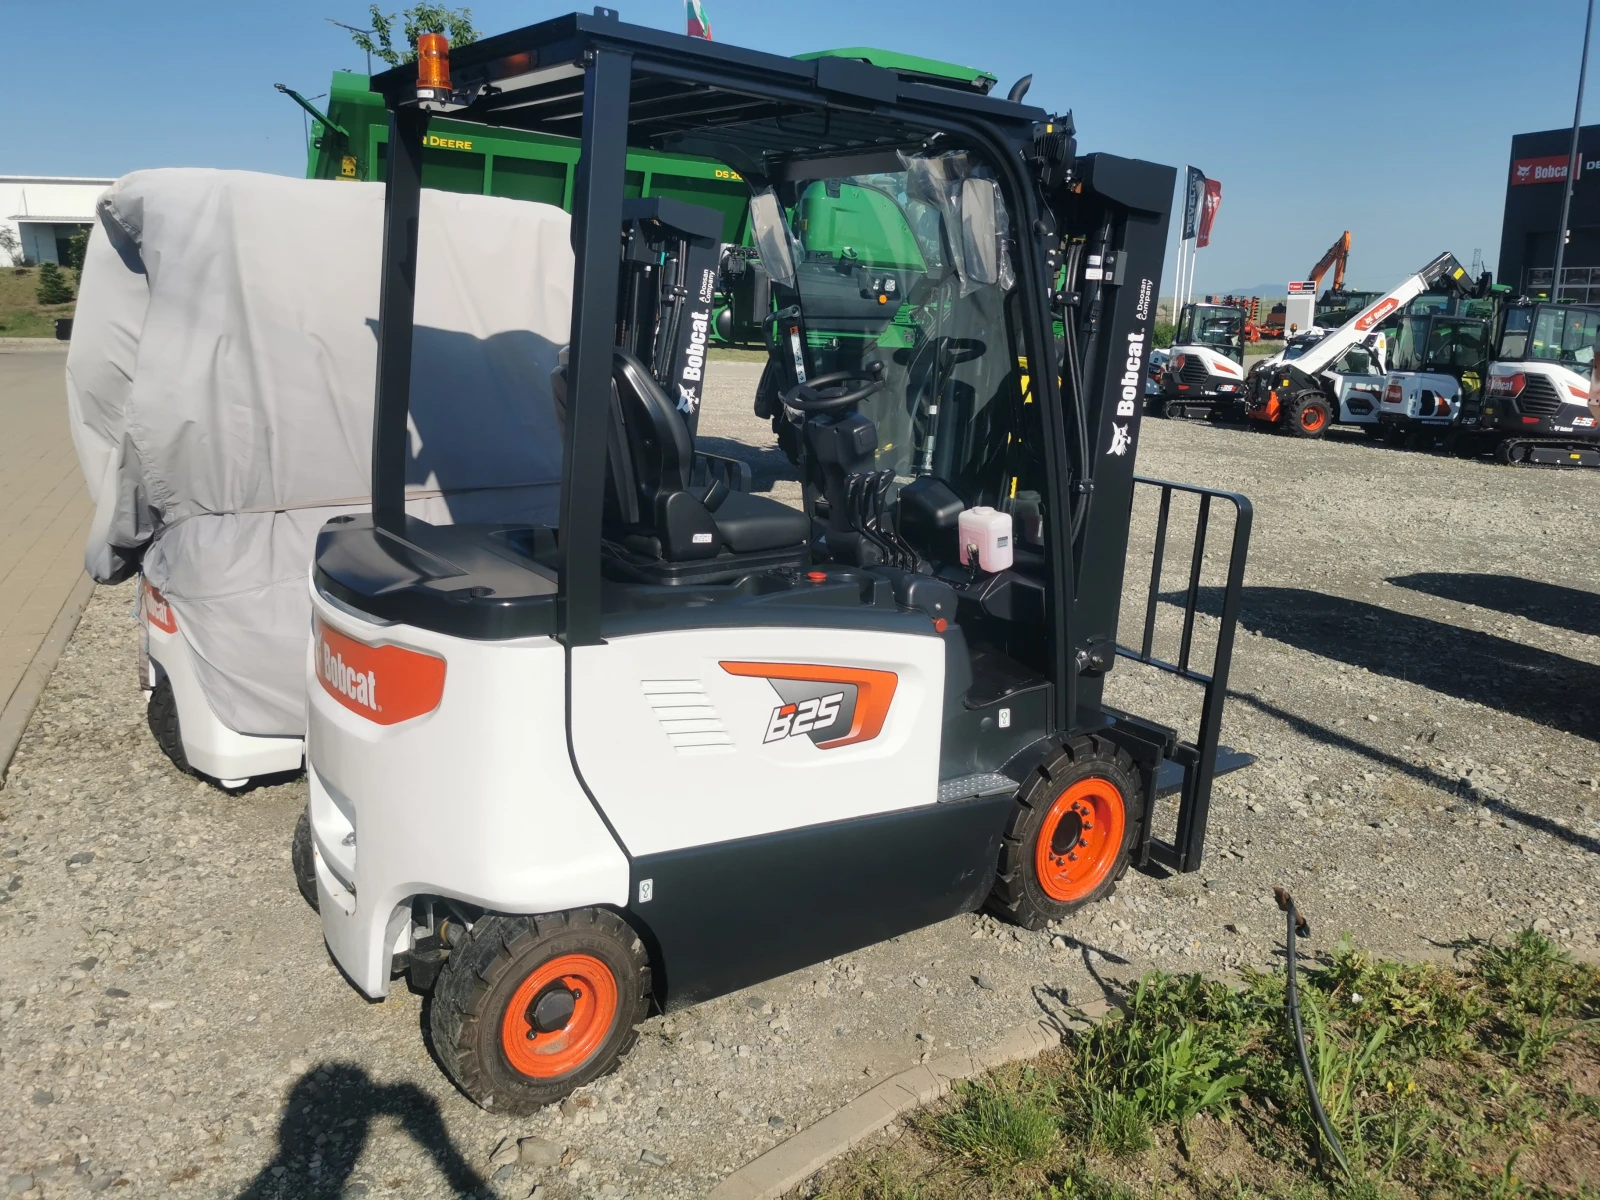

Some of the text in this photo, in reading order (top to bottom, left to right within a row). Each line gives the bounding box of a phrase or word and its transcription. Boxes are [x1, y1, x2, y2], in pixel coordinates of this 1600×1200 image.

[430, 135, 472, 150] DEERE
[715, 169, 729, 179] DS
[1534, 164, 1568, 180] Bobca
[700, 269, 709, 296] Doosan
[705, 270, 716, 304] Company
[1137, 278, 1147, 312] Doosan
[1141, 279, 1154, 321] Company
[1373, 302, 1394, 319] Bobcat
[683, 311, 709, 382] Bobcat
[1117, 332, 1145, 417] Bobcat
[323, 641, 377, 711] Bobcat
[763, 691, 844, 744] B25
